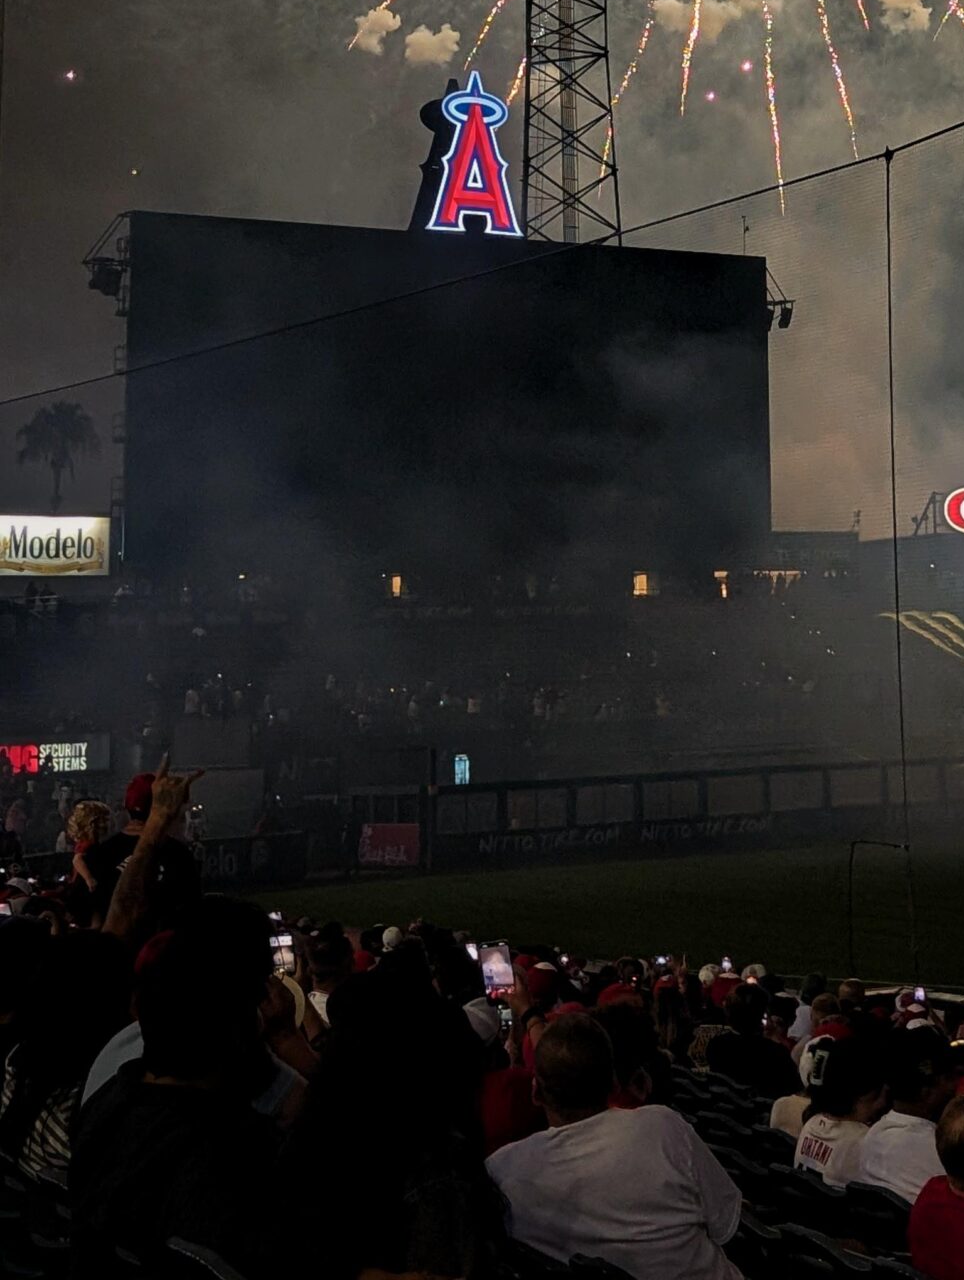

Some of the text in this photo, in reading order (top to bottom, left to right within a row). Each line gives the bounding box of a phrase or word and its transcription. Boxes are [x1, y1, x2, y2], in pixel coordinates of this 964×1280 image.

[425, 70, 525, 237] A
[8, 525, 94, 559] Modelo
[39, 757, 87, 772] SSTEMS
[801, 1136, 833, 1167] OHTANI
